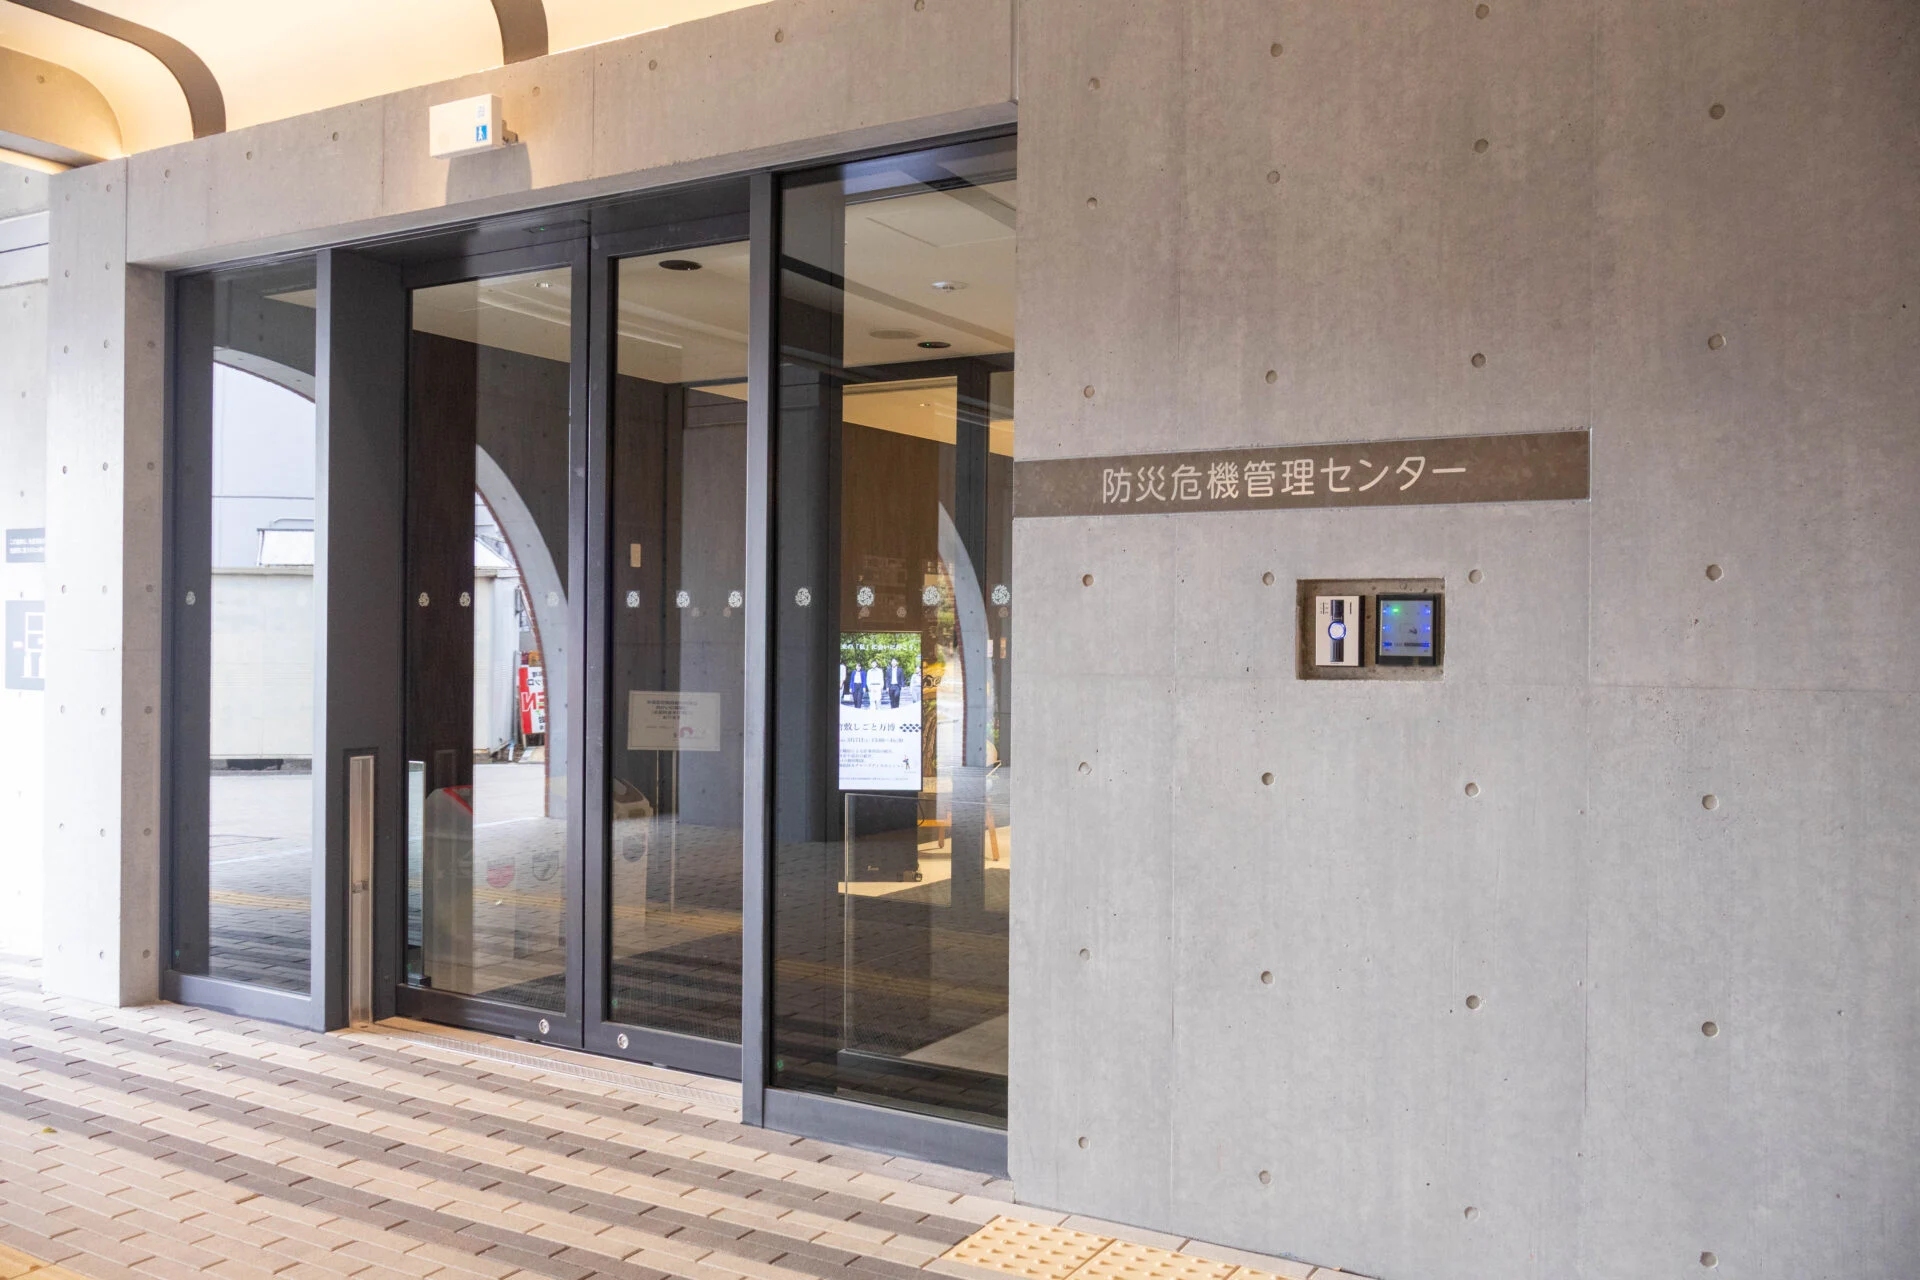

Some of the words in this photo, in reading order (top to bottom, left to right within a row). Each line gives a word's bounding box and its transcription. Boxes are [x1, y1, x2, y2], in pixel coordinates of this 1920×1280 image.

[1102, 456, 1466, 504] 防災危機管理センター
